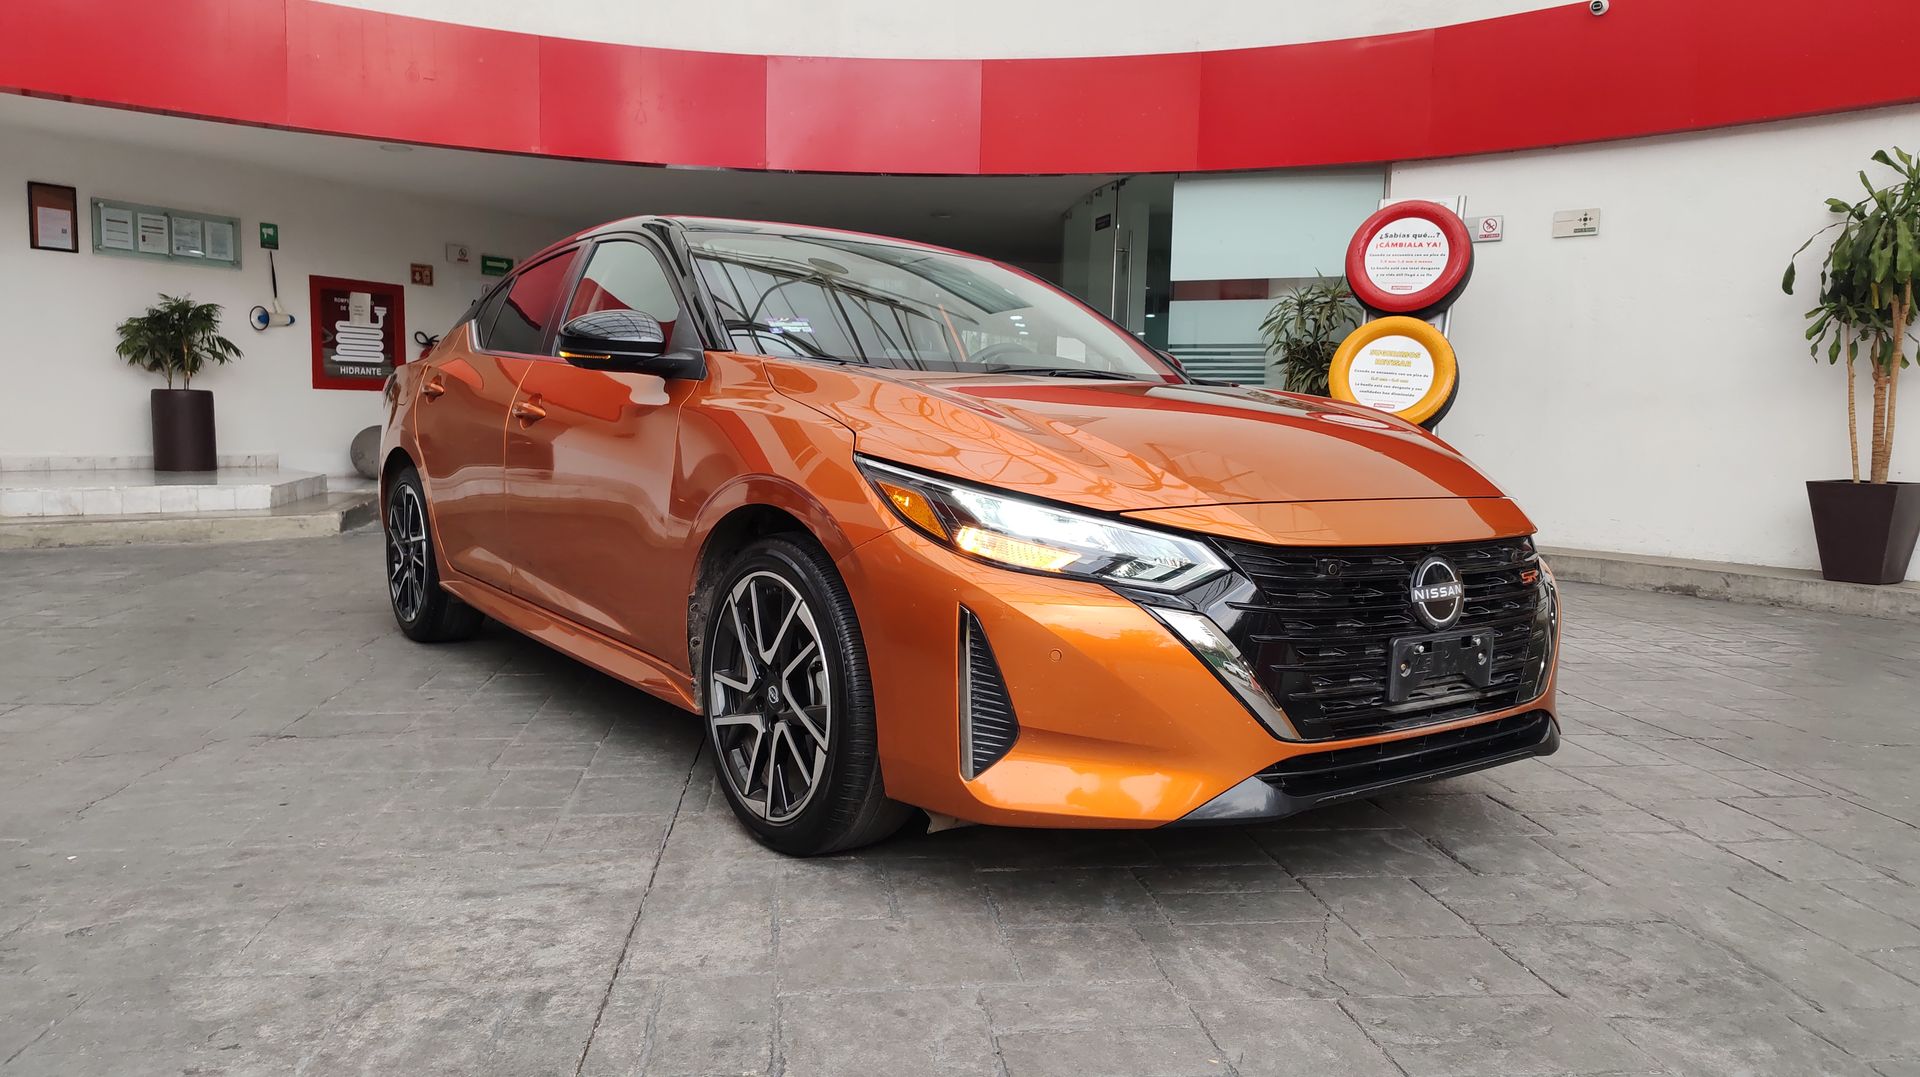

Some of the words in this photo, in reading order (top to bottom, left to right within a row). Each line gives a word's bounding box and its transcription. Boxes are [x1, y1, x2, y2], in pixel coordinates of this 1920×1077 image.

[340, 366, 382, 375] HIDRANTE
[1521, 569, 1538, 584] SR
[1414, 584, 1462, 600] NISSAN
